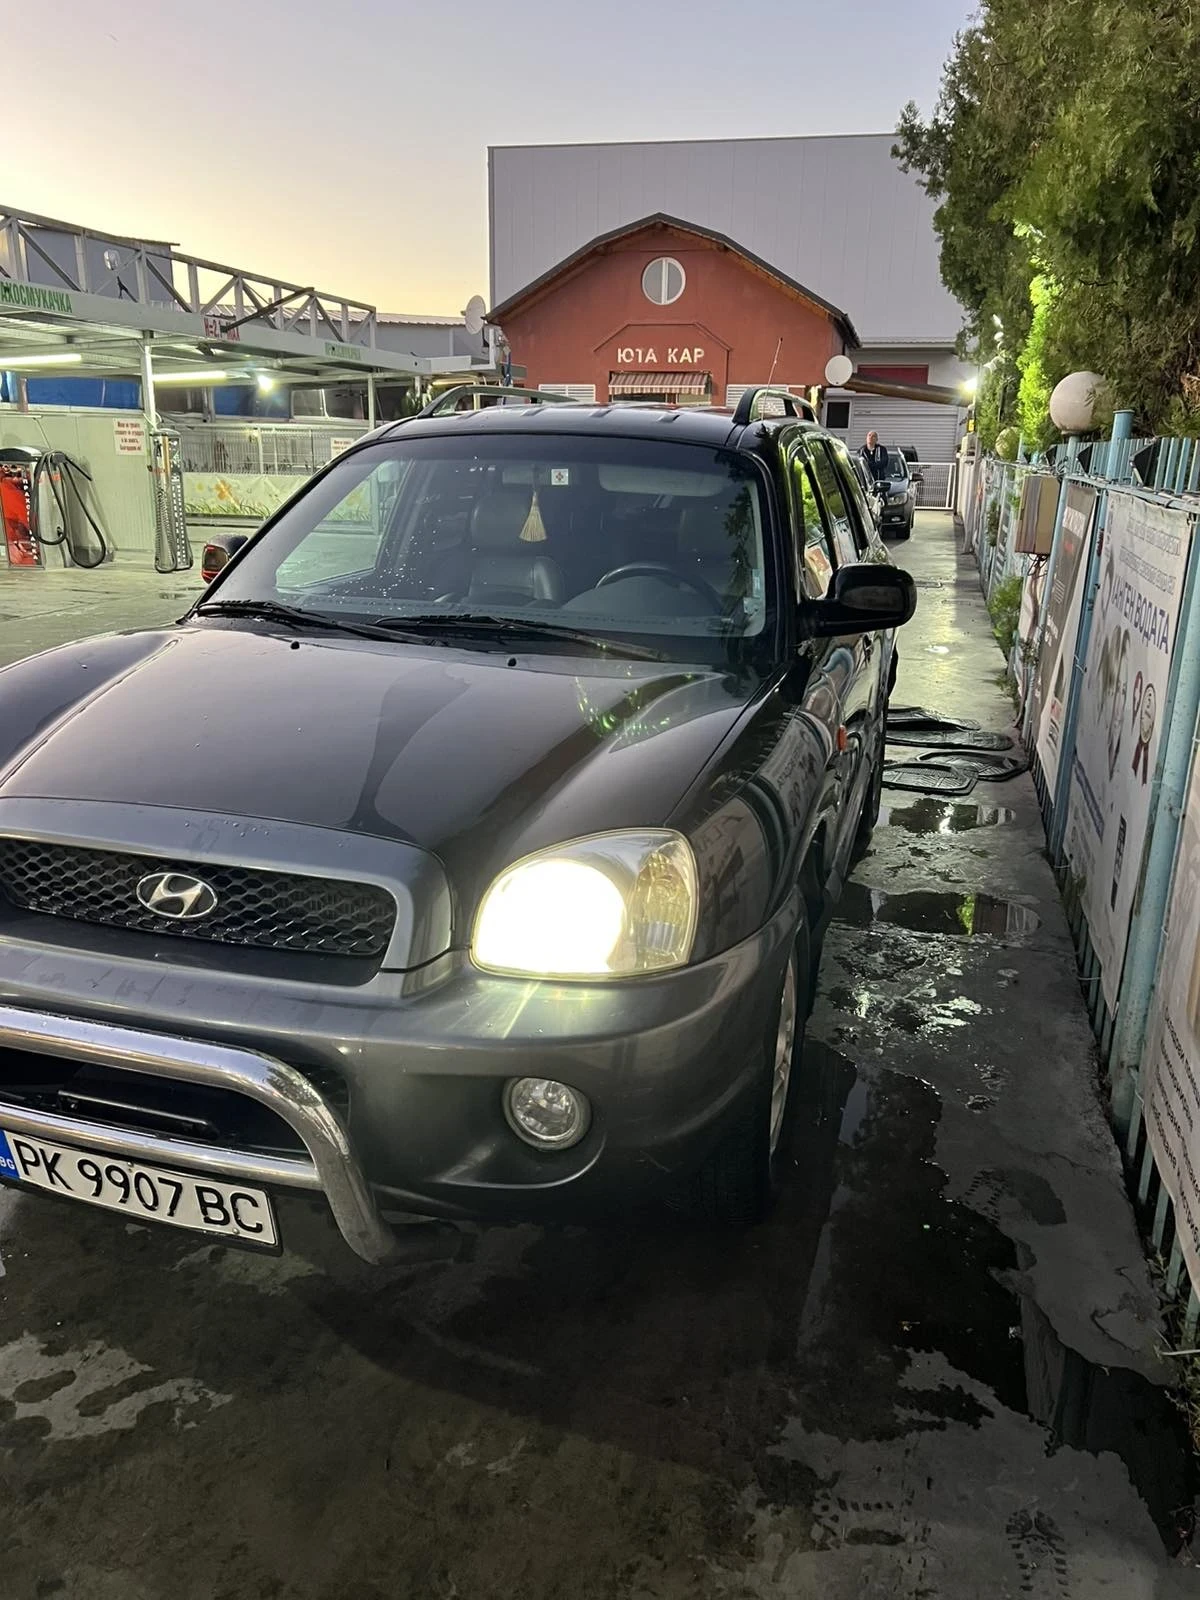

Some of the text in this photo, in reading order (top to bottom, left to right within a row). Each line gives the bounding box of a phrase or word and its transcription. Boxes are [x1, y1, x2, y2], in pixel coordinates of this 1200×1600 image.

[617, 348, 705, 364] ЮТА КАР
[1133, 591, 1171, 655] ВОДАТА
[12, 1138, 264, 1234] PK 9907 BC
